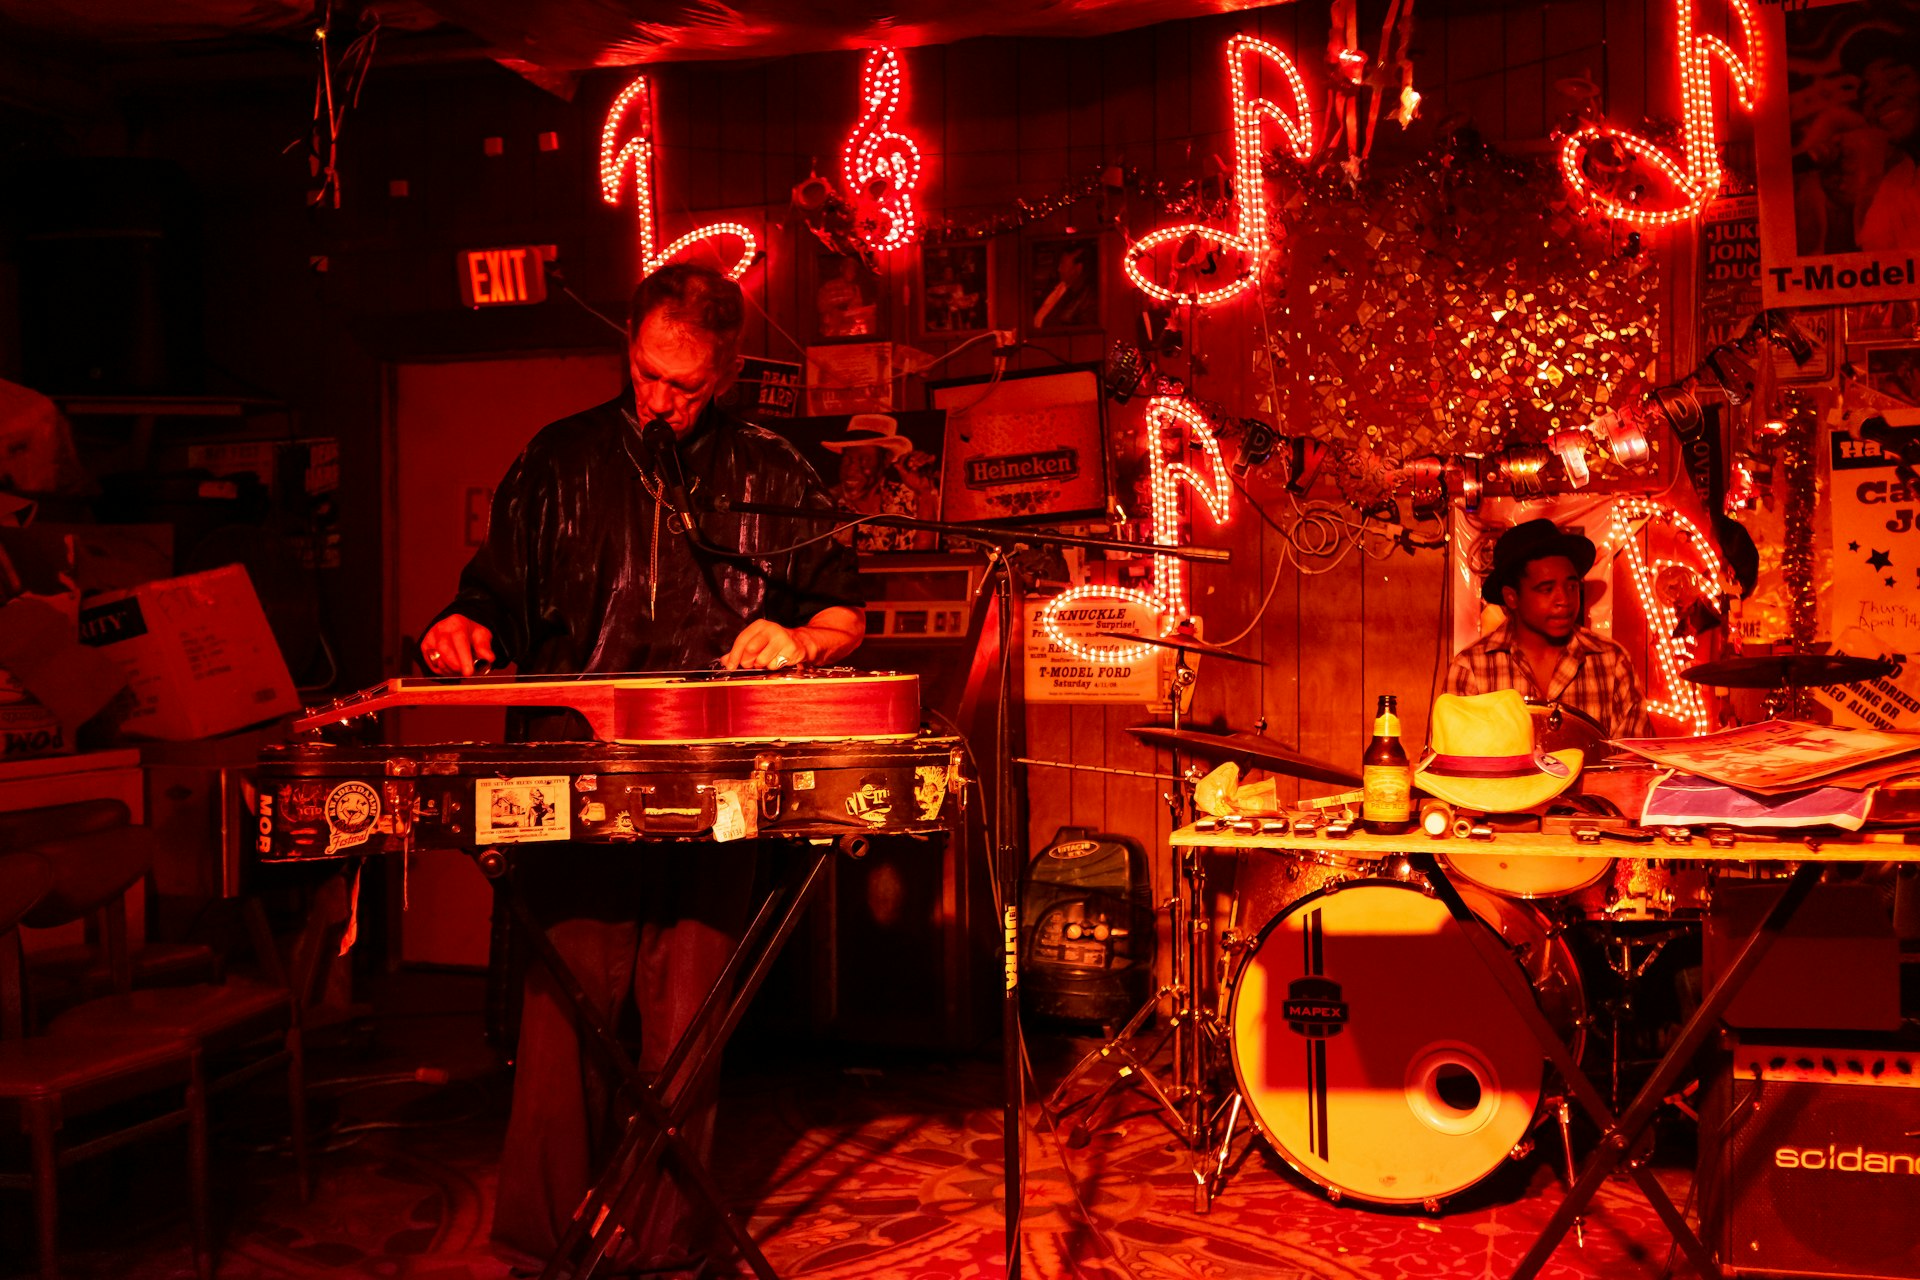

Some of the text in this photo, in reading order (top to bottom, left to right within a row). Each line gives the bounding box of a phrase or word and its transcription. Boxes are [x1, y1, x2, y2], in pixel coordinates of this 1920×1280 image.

[467, 249, 529, 304] EXIT
[1769, 258, 1916, 293] T-Model
[972, 455, 1073, 482] Heineken
[1886, 509, 1920, 533] J
[1032, 608, 1127, 622] PKNUCKLE
[1095, 619, 1136, 630] Surprise!
[1039, 666, 1132, 678] T-MODEL FORD
[1053, 679, 1092, 689] Saturday
[1880, 701, 1901, 720] OR
[259, 793, 273, 853] MOR
[326, 833, 368, 854] Festival
[1005, 911, 1018, 990] ULTRA
[1289, 1006, 1341, 1017] MAPEX
[1774, 1143, 1920, 1175] soldan
